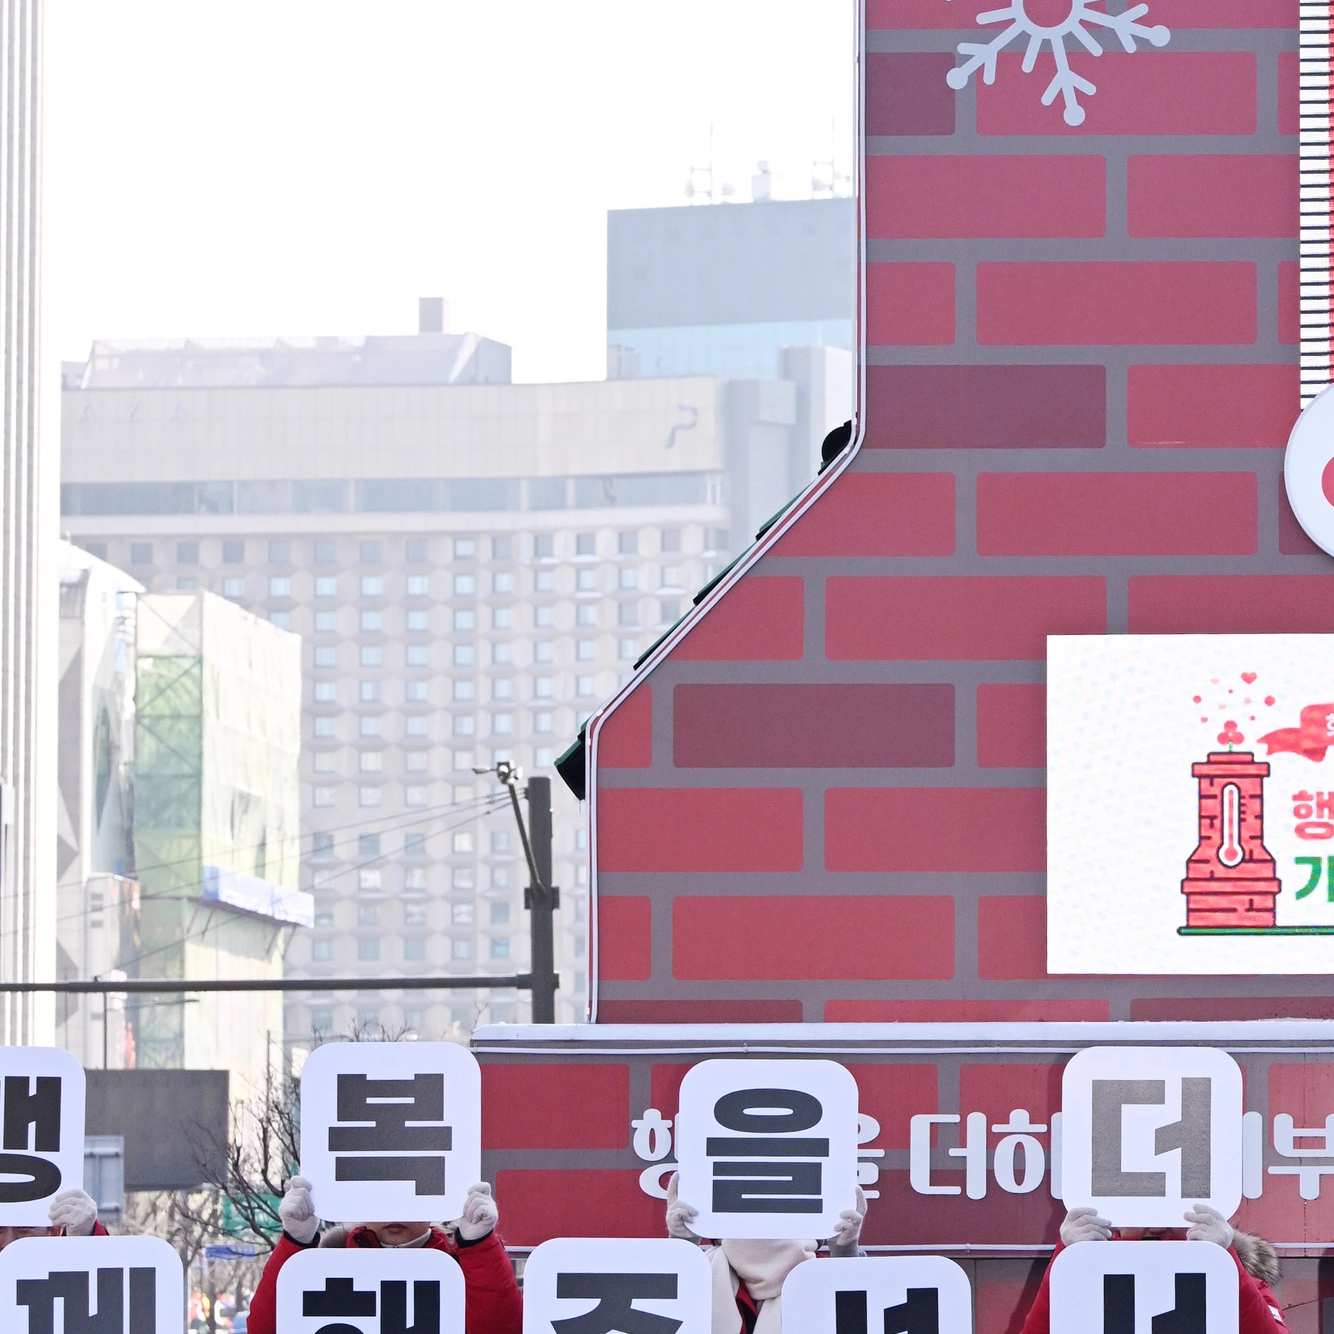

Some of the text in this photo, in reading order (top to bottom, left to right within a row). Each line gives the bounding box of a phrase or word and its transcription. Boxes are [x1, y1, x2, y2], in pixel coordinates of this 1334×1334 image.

[328, 1073, 452, 1196] 복
[706, 1088, 830, 1214] 을
[910, 1109, 1064, 1200] 더하
[1091, 1077, 1211, 1198] 더
